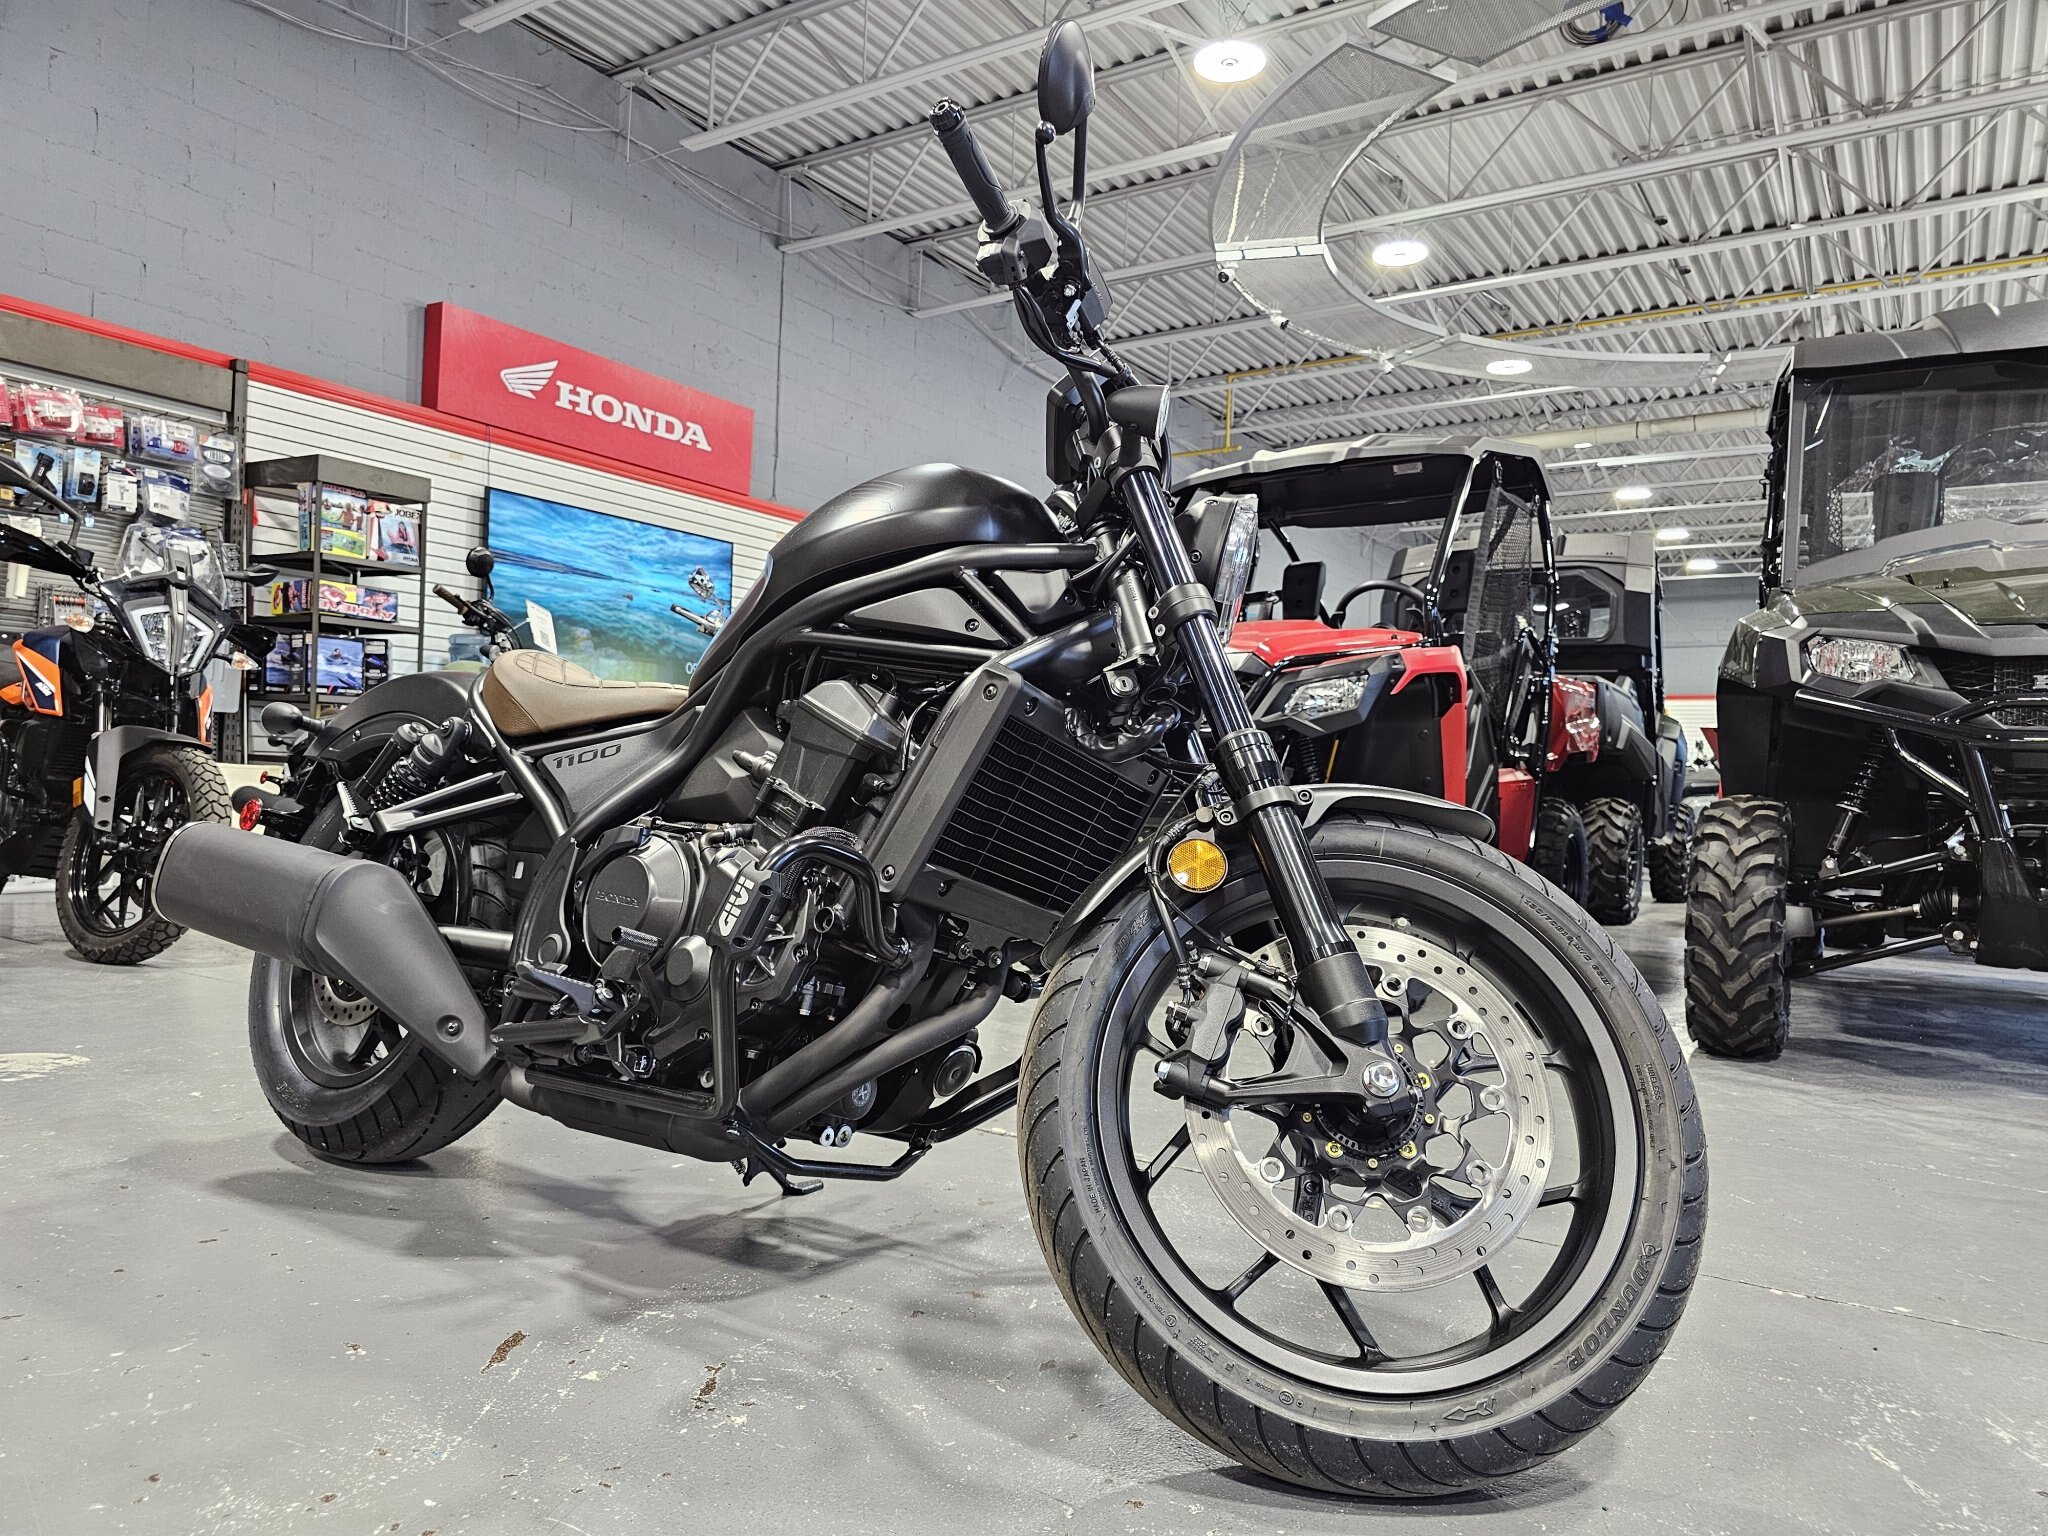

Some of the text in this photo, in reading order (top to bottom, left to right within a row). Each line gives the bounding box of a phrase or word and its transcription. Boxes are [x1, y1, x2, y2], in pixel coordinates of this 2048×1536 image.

[555, 380, 712, 452] HONDA
[552, 743, 622, 769] 1100
[595, 890, 640, 908] HONDA
[718, 875, 755, 937] GIVI
[1646, 1062, 1662, 1101] TUBELESS
[1080, 1157, 1090, 1181] JAPAN
[1090, 1193, 1101, 1213] MADE
[1566, 1257, 1652, 1372] DUNLOP
